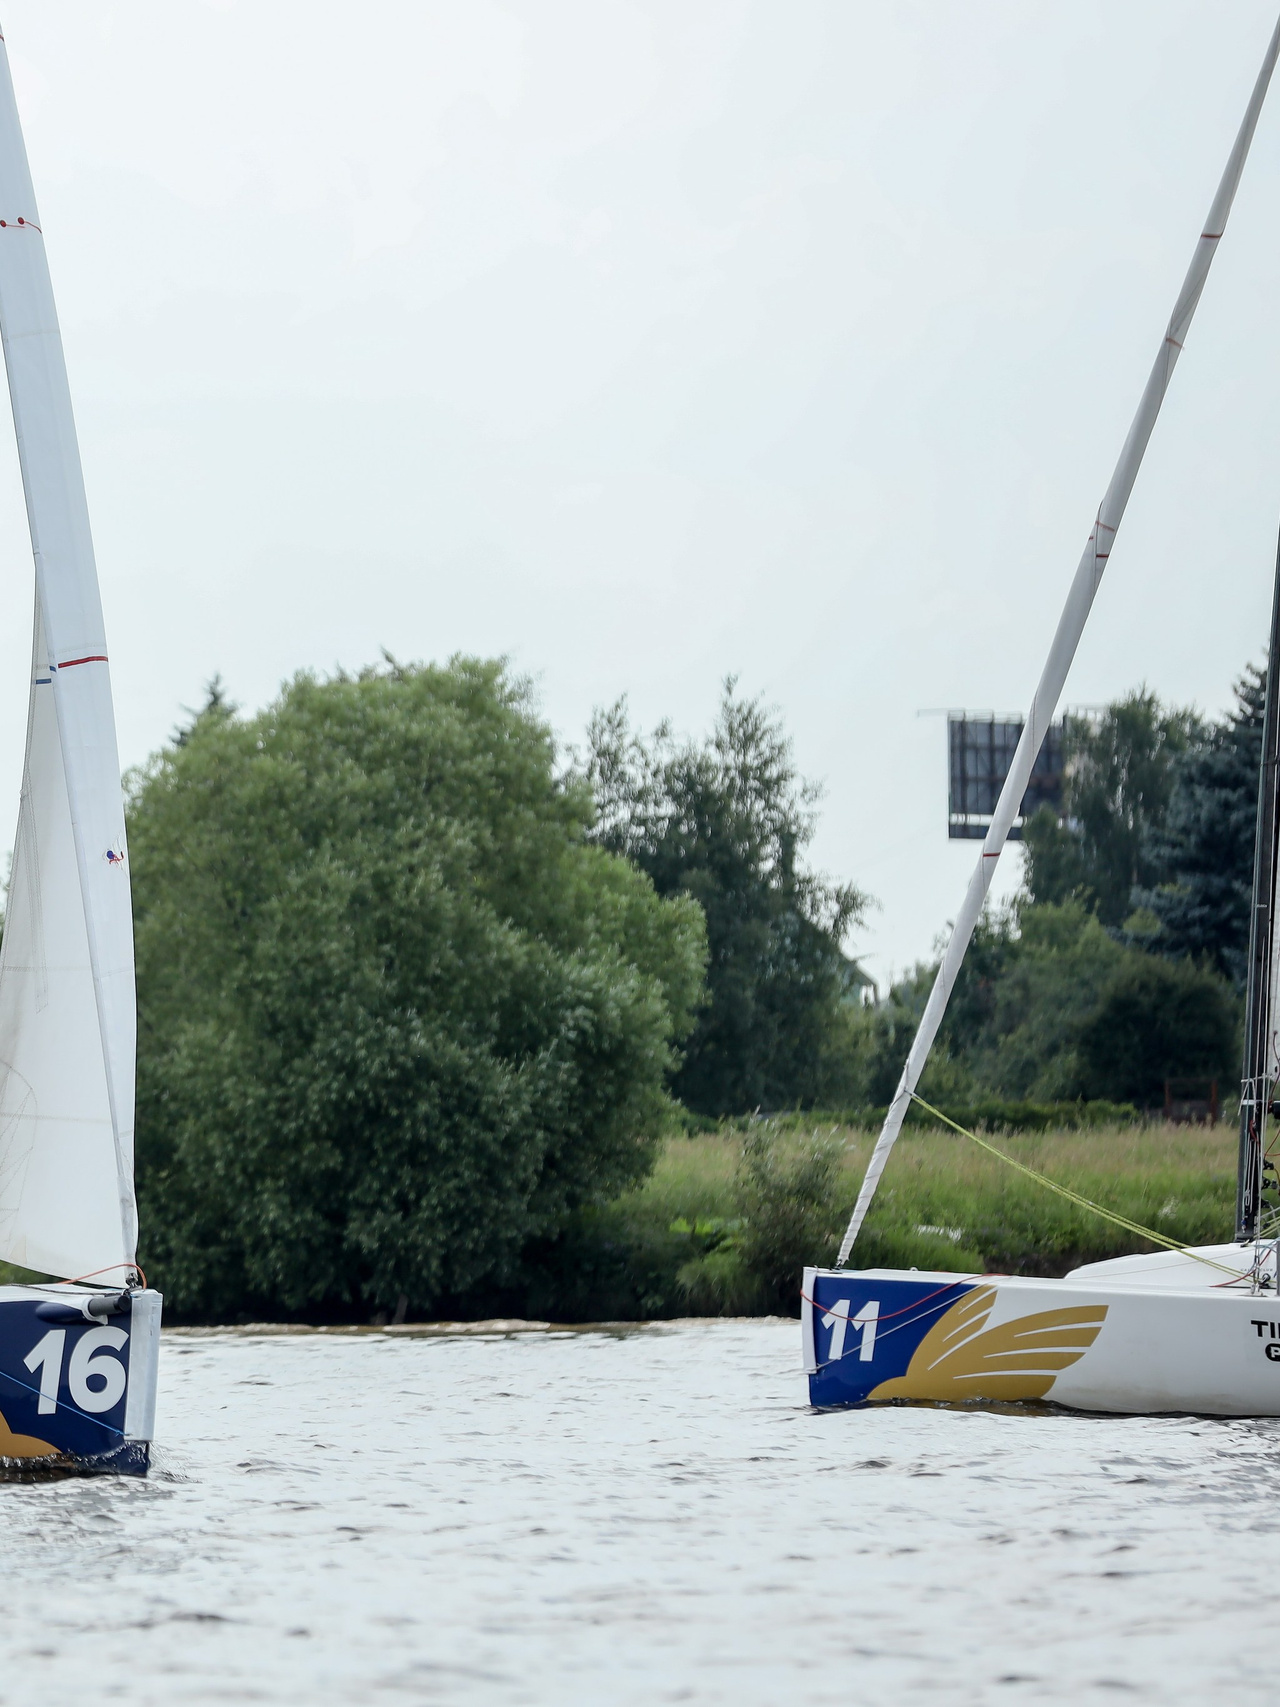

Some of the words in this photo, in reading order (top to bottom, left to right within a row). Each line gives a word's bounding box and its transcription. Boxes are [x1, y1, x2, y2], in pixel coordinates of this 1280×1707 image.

[821, 1298, 880, 1362] 11
[1250, 1319, 1280, 1339] TI
[23, 1325, 130, 1415] 16
